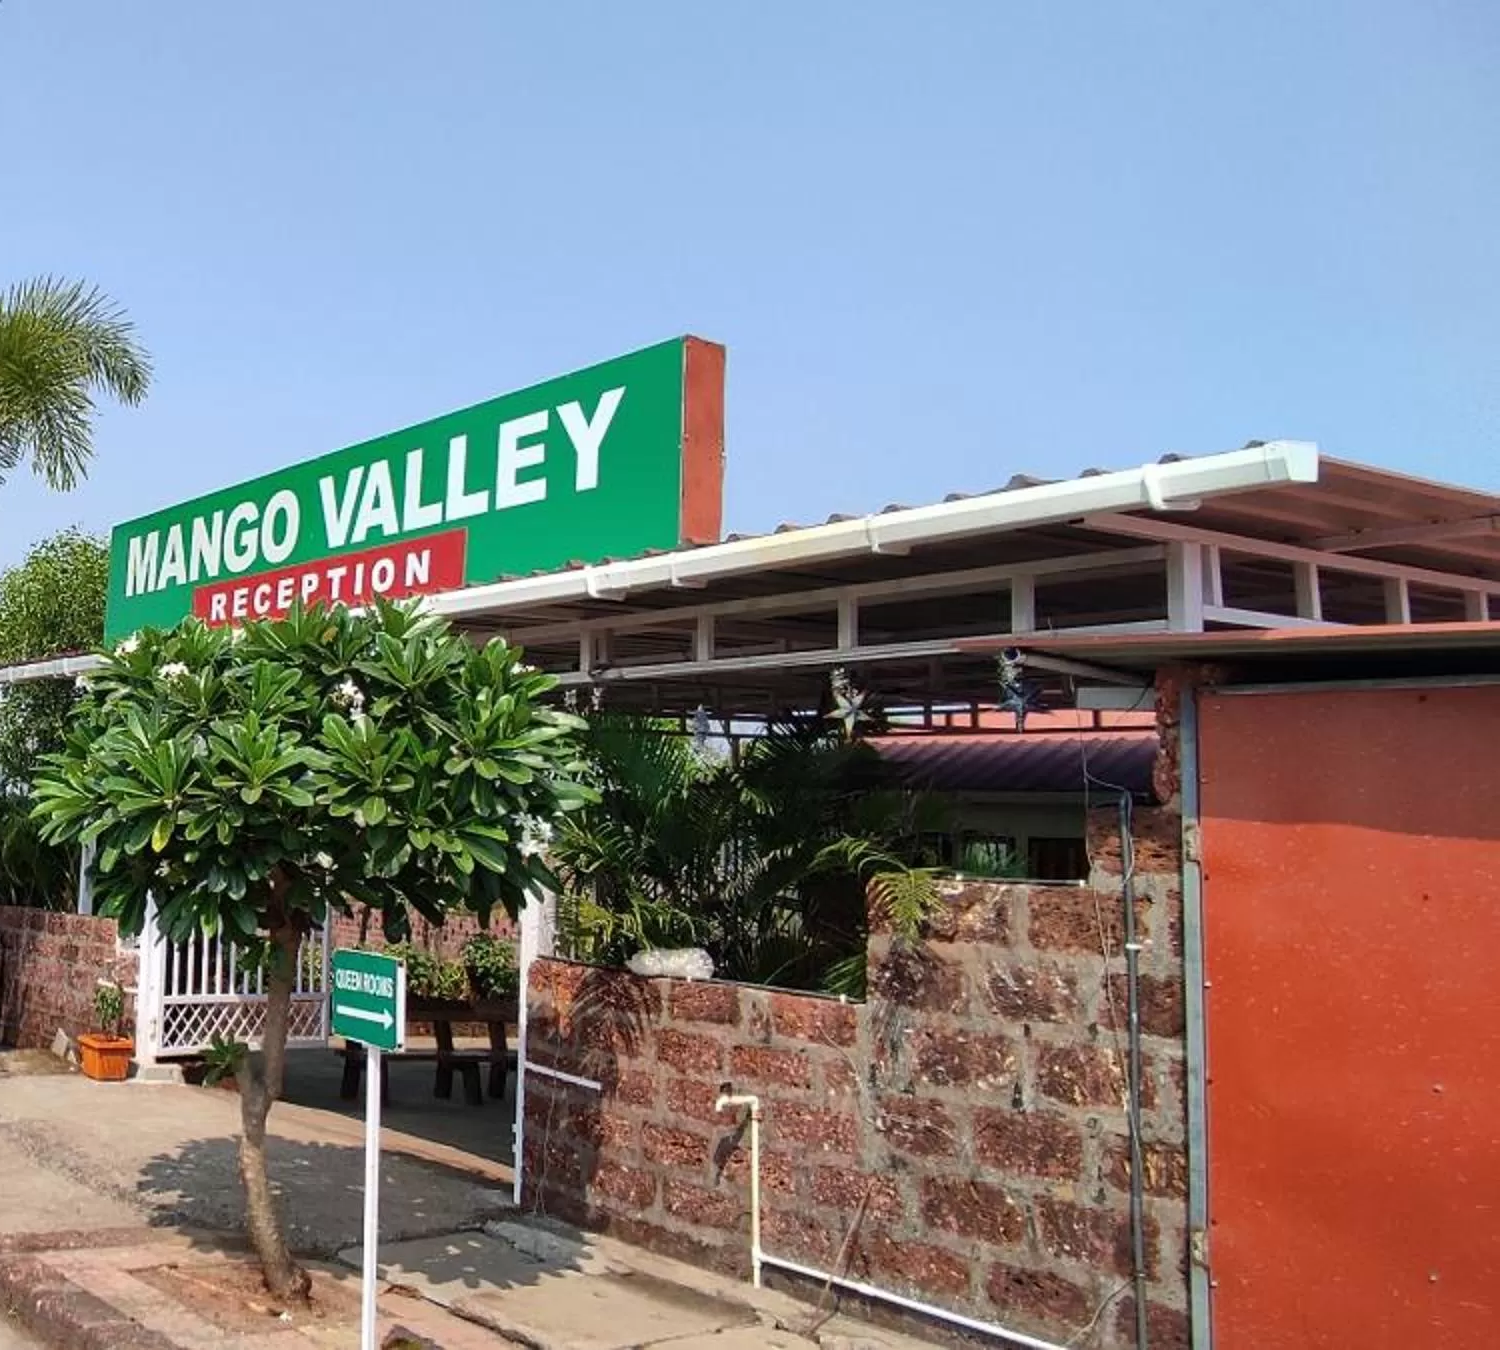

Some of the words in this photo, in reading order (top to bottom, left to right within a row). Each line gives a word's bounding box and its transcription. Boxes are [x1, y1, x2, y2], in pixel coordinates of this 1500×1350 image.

[125, 489, 300, 598] MANGO
[319, 386, 626, 549] VALLEY
[211, 549, 431, 621] RECEPTION
[336, 968, 361, 991] QUEEN
[363, 972, 393, 998] ROOMS
